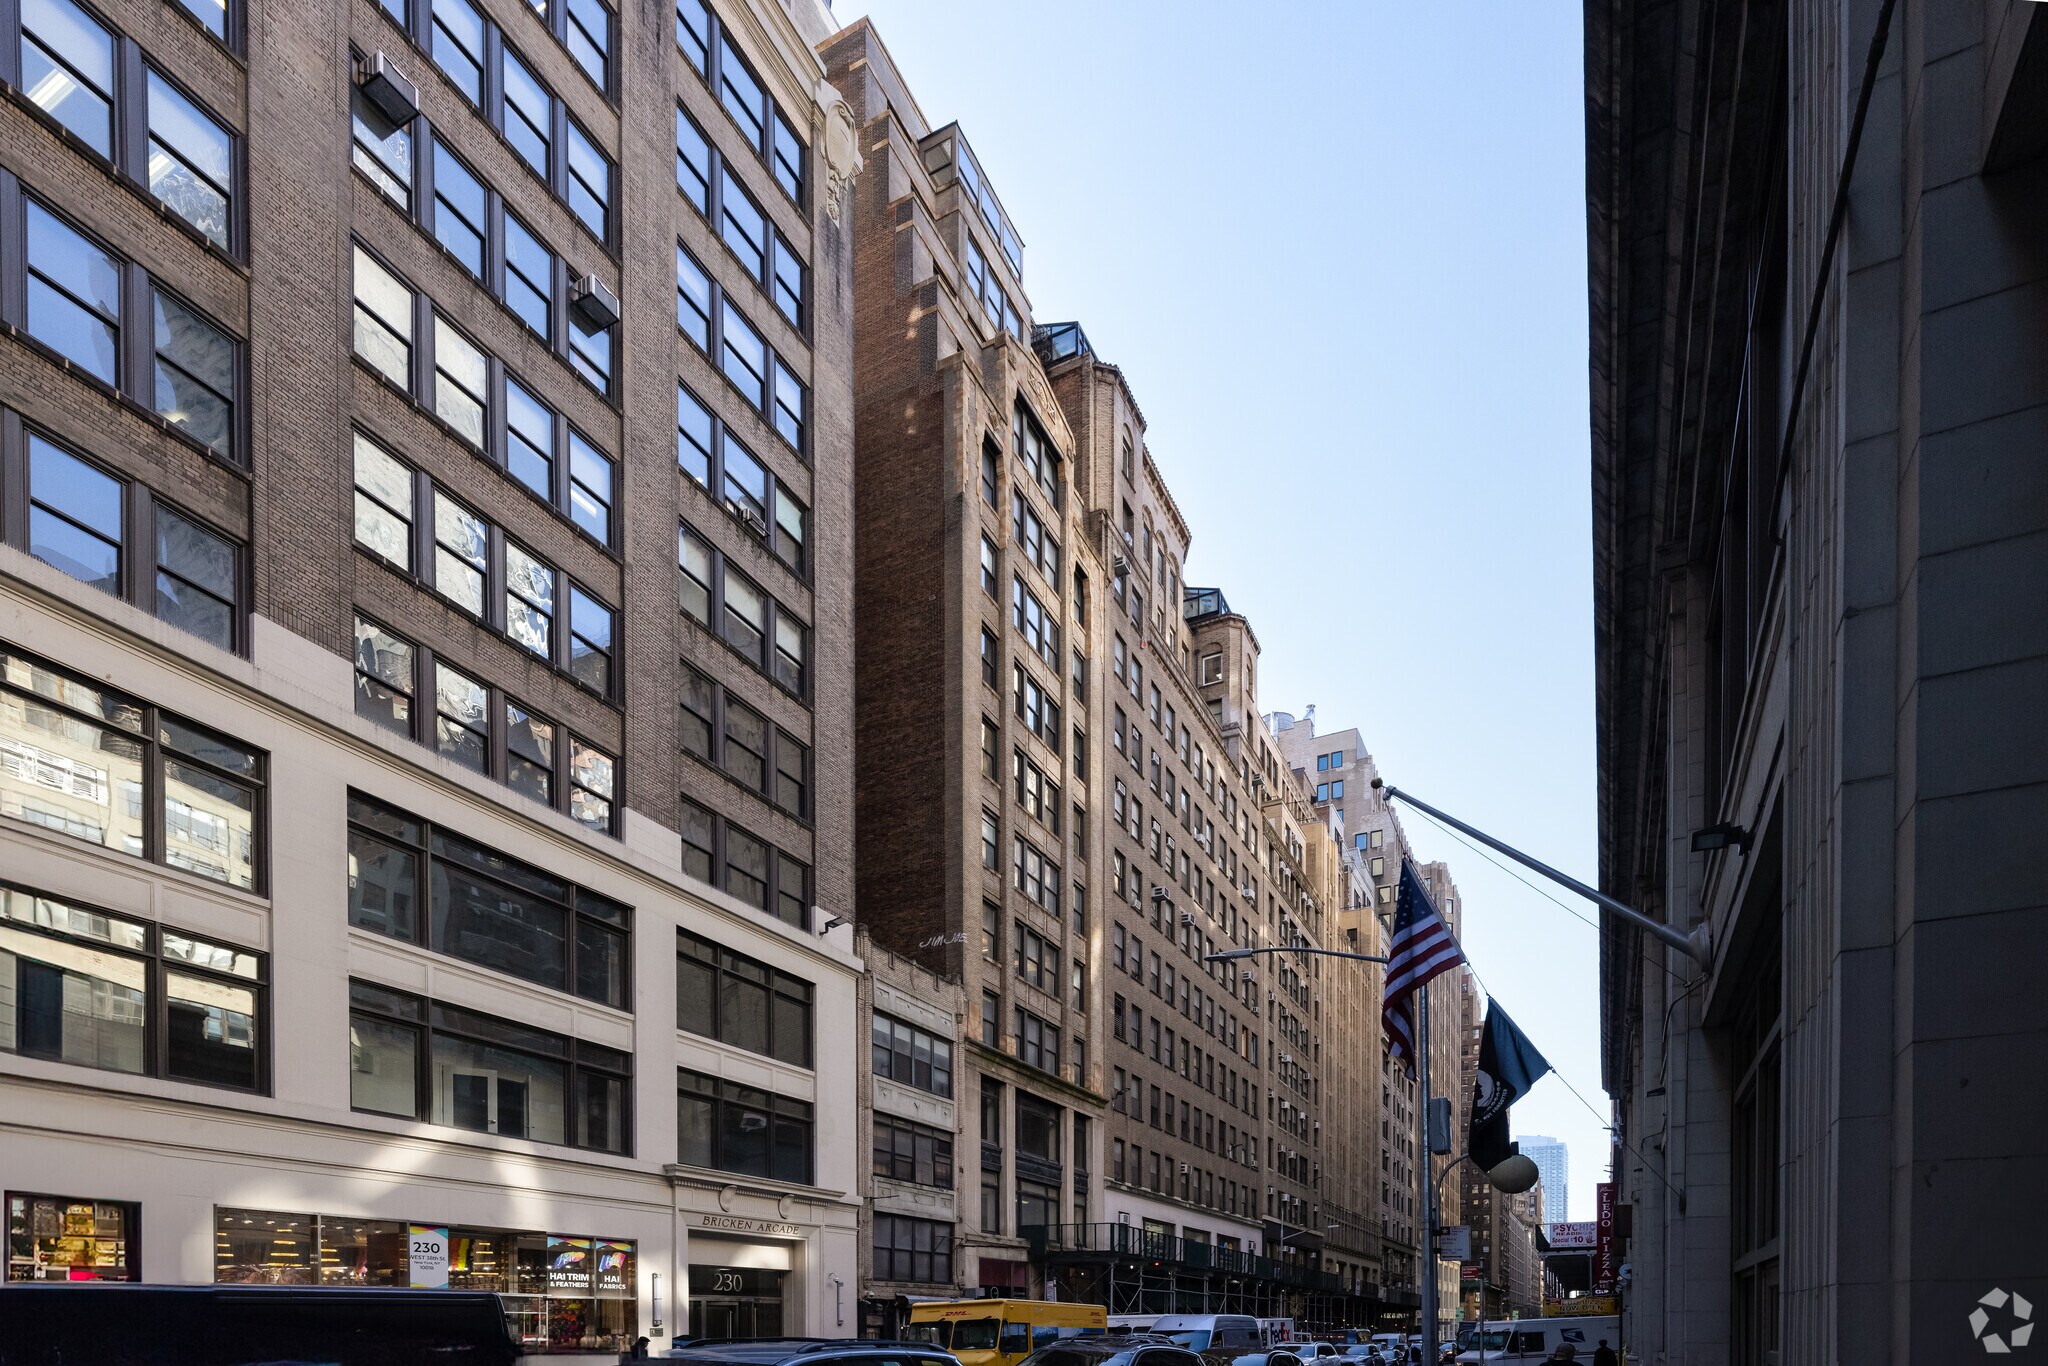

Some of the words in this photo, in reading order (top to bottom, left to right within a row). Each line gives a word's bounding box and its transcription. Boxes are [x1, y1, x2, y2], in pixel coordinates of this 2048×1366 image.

[919, 934, 945, 948] JIM
[702, 1216, 752, 1229] BRICKEN
[757, 1224, 799, 1234] ARCADE
[1552, 1223, 1595, 1232] PSYCHIC
[1552, 1236, 1569, 1244] Special
[414, 1242, 440, 1253] 230
[1602, 1236, 1610, 1276] PIZZA
[604, 1275, 620, 1283] HAI
[713, 1272, 743, 1292] 230
[1270, 1322, 1290, 1344] FedEx
